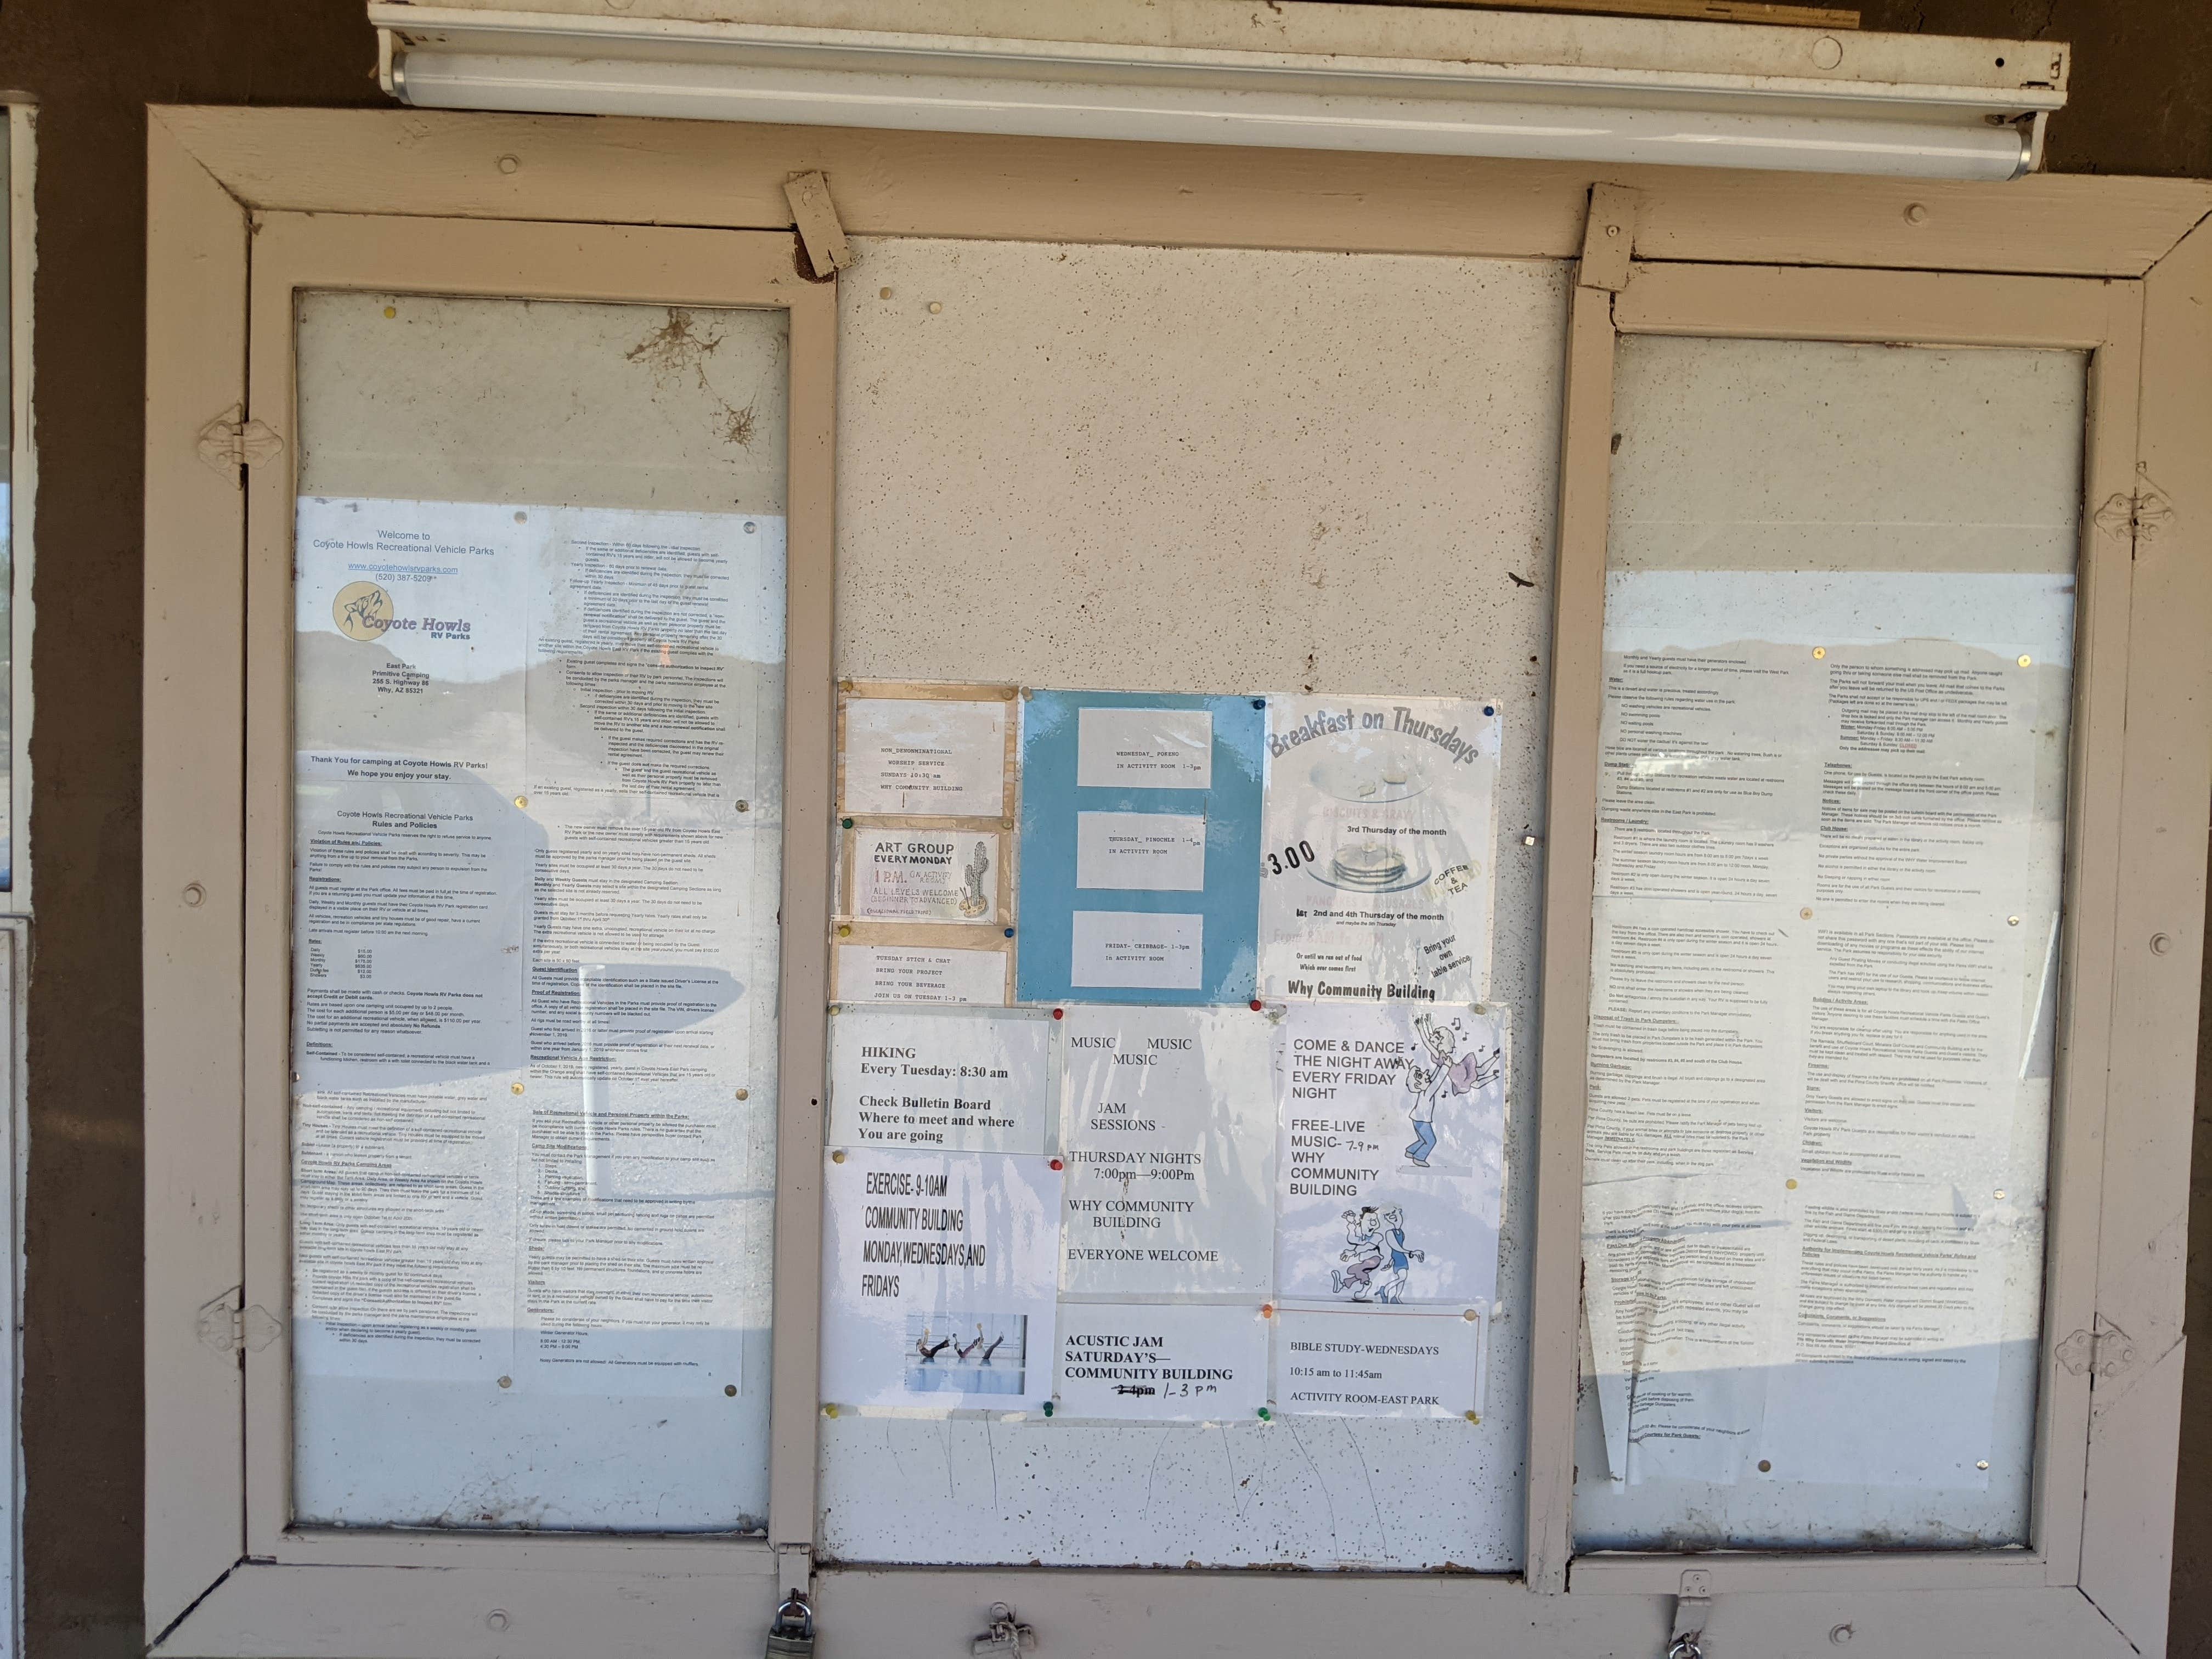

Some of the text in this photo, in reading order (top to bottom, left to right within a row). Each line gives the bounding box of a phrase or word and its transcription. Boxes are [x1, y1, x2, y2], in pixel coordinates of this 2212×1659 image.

[377, 530, 430, 540] Welcome to
[313, 540, 494, 555] Coyote Howls Recreational Vehicle Parks
[348, 562, 458, 574] www.coyotehowlsrvparks.com
[375, 573, 395, 582] (520)
[362, 616, 471, 632] Coyote Howls
[1266, 707, 1479, 765] Breakfast on Thursdays
[1362, 827, 1396, 835] Thursday
[875, 842, 954, 854] ART GROUP
[909, 856, 952, 865] MONDAY
[1433, 864, 1469, 885] COFFEE
[891, 888, 919, 896] LEVELS
[1447, 882, 1469, 895] TEA
[1288, 980, 1435, 1001] Why Community Building
[1071, 1037, 1192, 1049] MUSIC MUSIC
[1294, 1039, 1404, 1053] COME & DANCE
[861, 1046, 916, 1059] HIKING
[1113, 1054, 1158, 1065] MUSIC
[861, 1063, 1008, 1079] Every Tuesday: 8:30 am
[1293, 1071, 1396, 1085] EVERY FRIDAY
[1293, 1087, 1336, 1099] NIGHT
[859, 1096, 991, 1110] Check Bulletin Board
[1098, 1103, 1126, 1114] JAM
[1091, 1119, 1155, 1131] SESSIONS
[1292, 1120, 1365, 1132] FREE-LIVE
[1291, 1136, 1342, 1148] MUSIC-
[1069, 1151, 1201, 1164] THURSDAY NIGHTS
[866, 1172, 947, 1197] EXERCISE- 9-10AM
[1069, 1200, 1194, 1212] WHY COMMUNITY
[865, 1206, 963, 1231] COMMUNITY BUILDING
[1093, 1217, 1160, 1228] BUILDING
[1068, 1249, 1218, 1262] EVERYONE WELCOME
[861, 1274, 900, 1297] FRIDAYS
[1065, 1335, 1163, 1347] ACUSTIC JAM
[1290, 1342, 1438, 1355] BIBLE STUDY-WEDNESDAYS
[1065, 1367, 1233, 1380] COMMUNITY BUILDING
[1290, 1367, 1314, 1376] 10:15
[1345, 1369, 1382, 1379] 11:45am
[1290, 1392, 1440, 1404] ACTIVITY ROOM-EAST PARK
